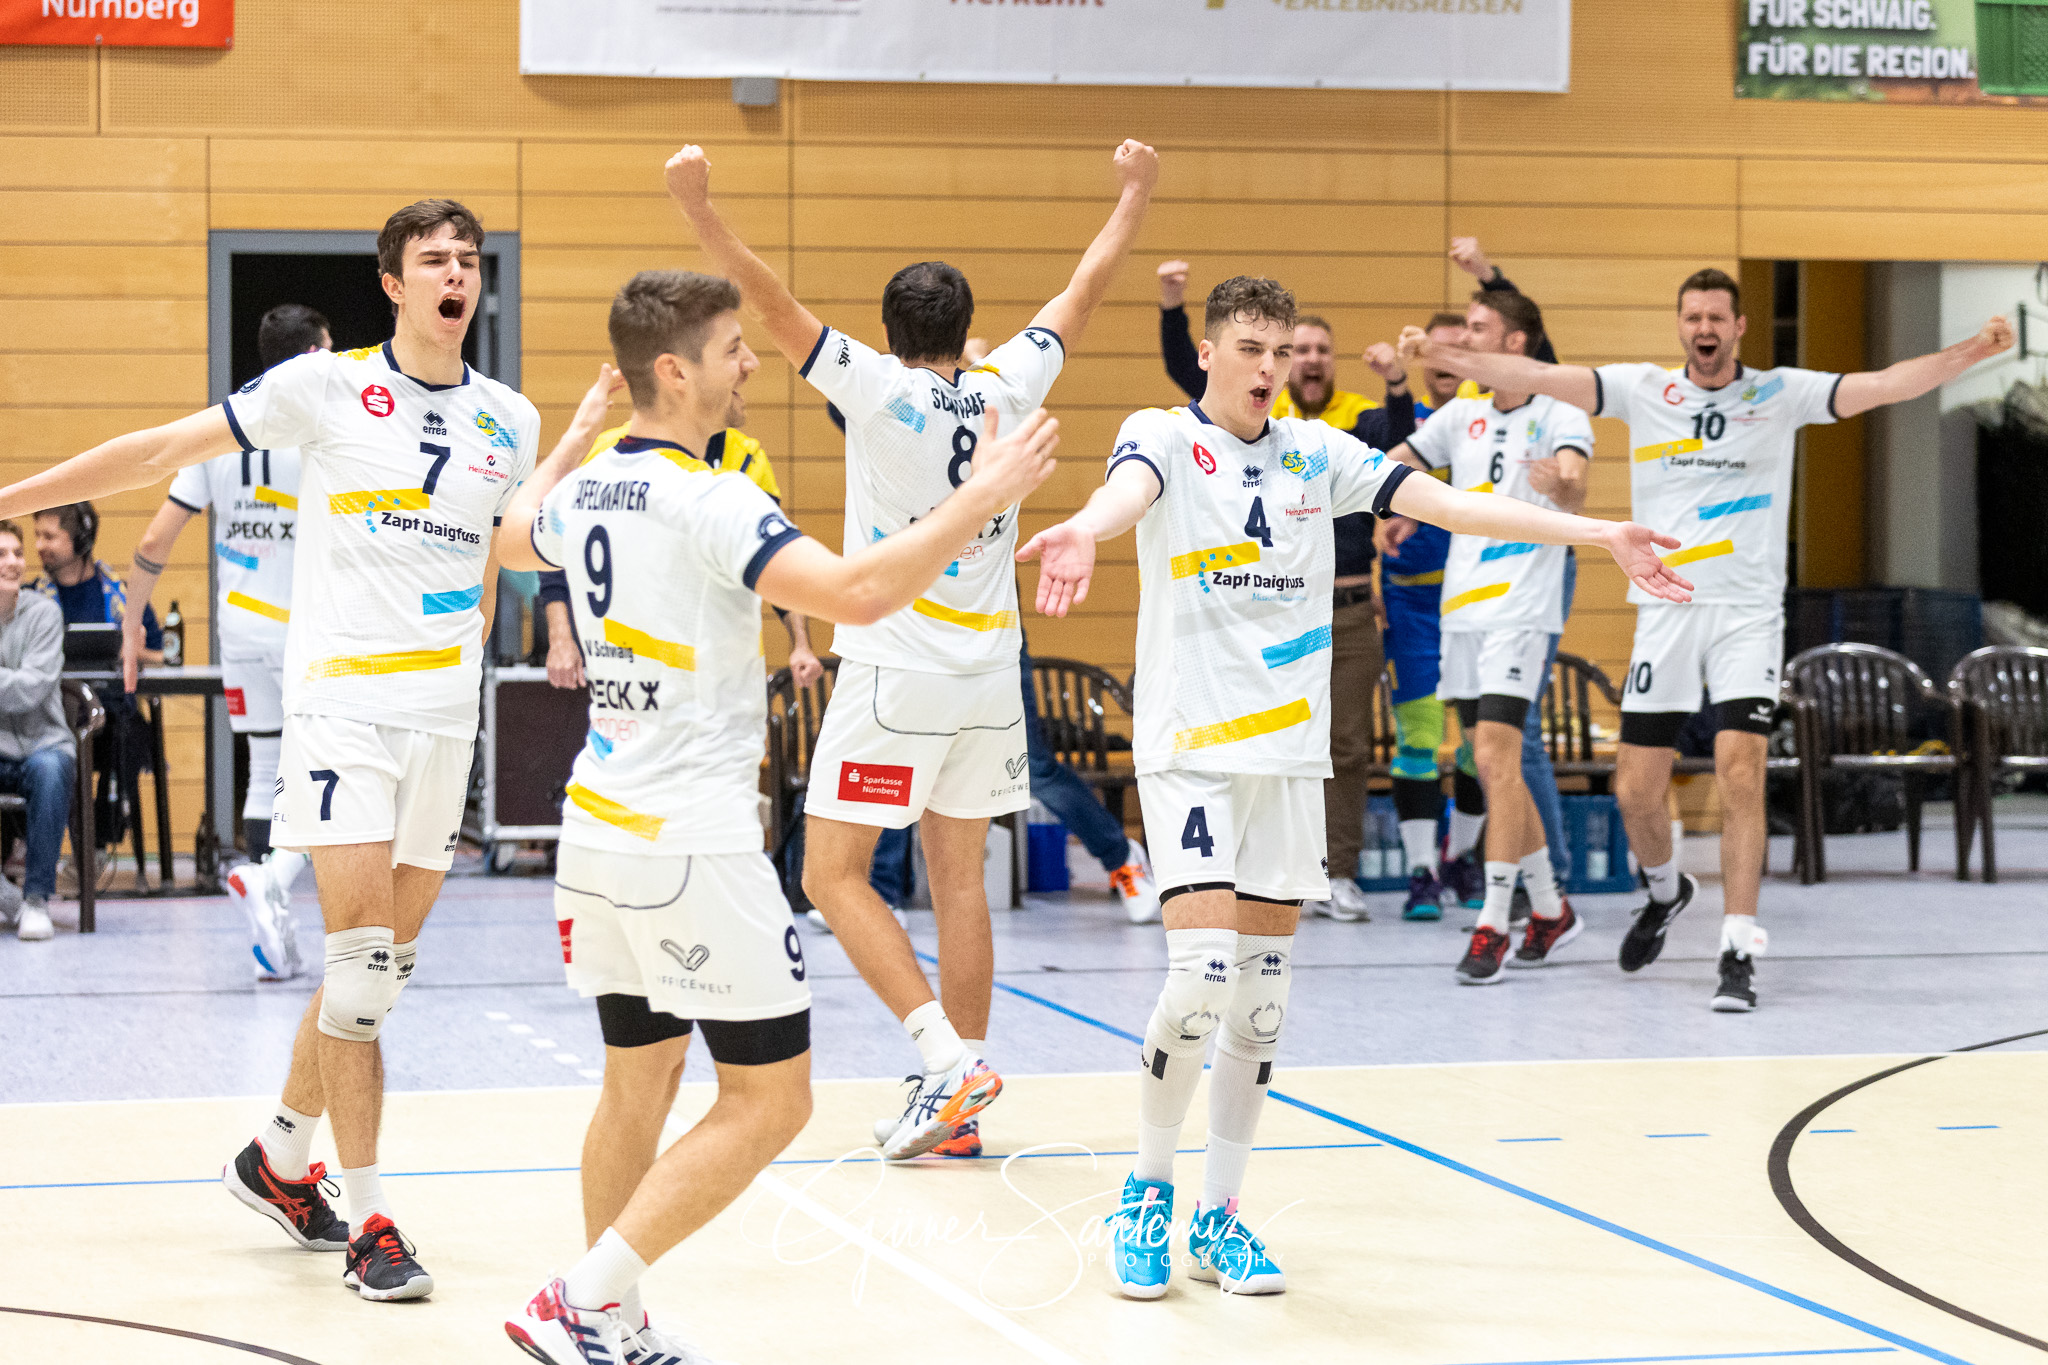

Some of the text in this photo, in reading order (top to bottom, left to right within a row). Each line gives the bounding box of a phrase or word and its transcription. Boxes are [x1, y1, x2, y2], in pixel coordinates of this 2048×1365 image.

[1813, 0, 1936, 30] SCHWAIG.
[1748, 37, 1976, 79] FÜR DIE REGION.
[423, 425, 447, 436] errea
[1690, 411, 1726, 441] 10
[420, 441, 451, 495] 7
[948, 425, 978, 490] 8
[1489, 451, 1504, 484] 6
[381, 511, 480, 544] Zapf Daigfuss
[1244, 496, 1273, 547] 4
[585, 525, 612, 618] 9
[1213, 571, 1305, 591] Zapf Daigfuss
[594, 640, 634, 664] Schwaig
[1627, 661, 1653, 694] 10
[309, 769, 340, 821] 7
[862, 785, 899, 797] Nürnberg
[863, 776, 903, 786] Sparkasse
[1181, 806, 1215, 858] 4
[367, 963, 388, 972] errea
[784, 925, 805, 981] 9
[656, 975, 732, 995] FFCEWELT
[1204, 972, 1226, 983] errea
[1261, 967, 1281, 976] errea
